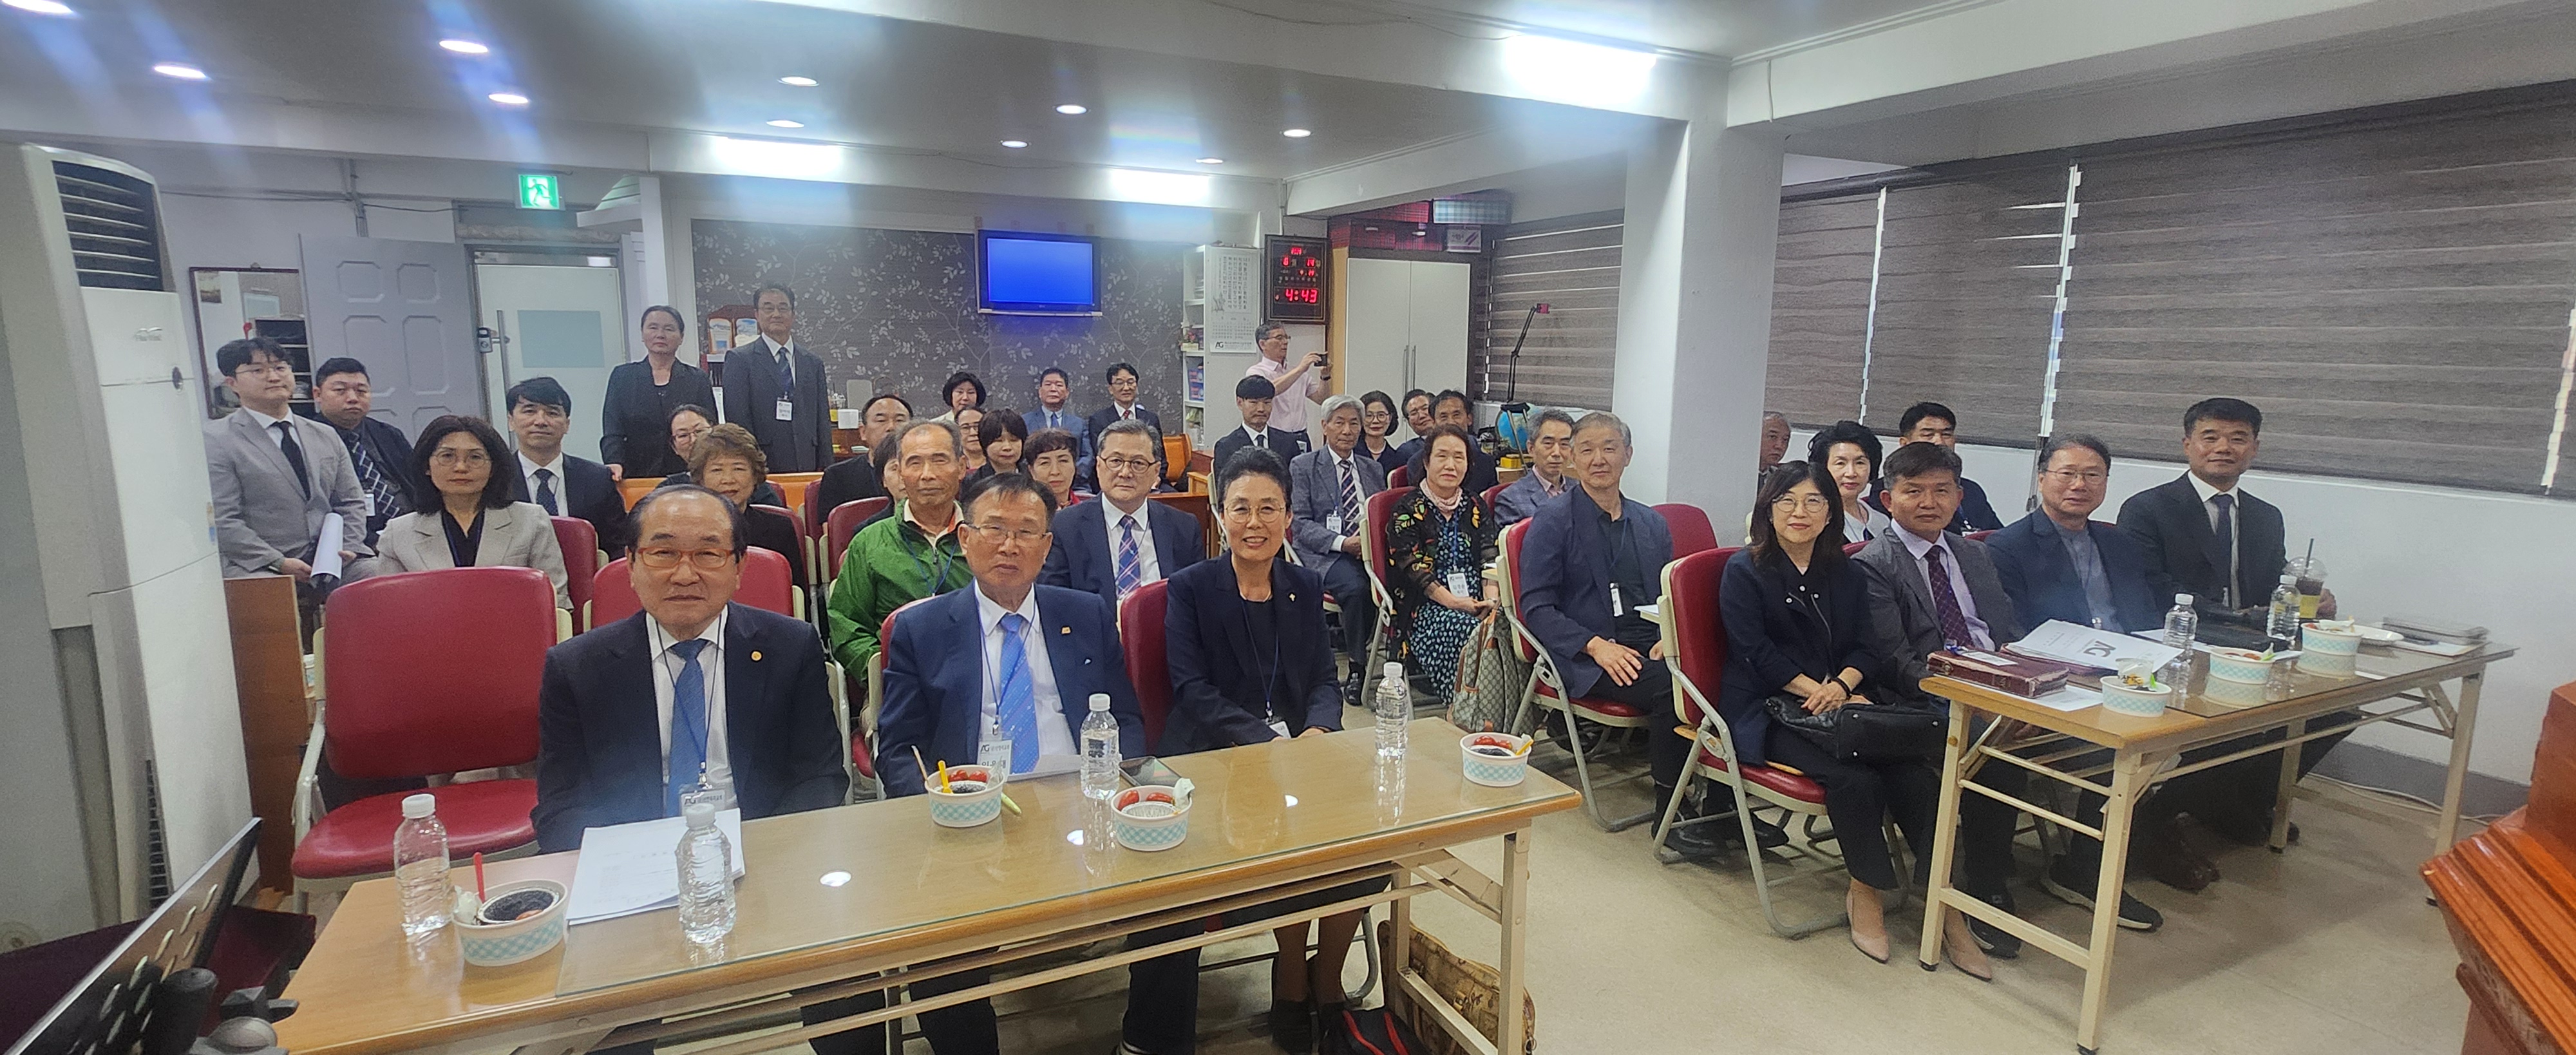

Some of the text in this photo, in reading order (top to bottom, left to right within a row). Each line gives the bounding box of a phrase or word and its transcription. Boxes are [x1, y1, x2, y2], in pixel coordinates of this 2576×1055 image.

[1285, 288, 1318, 303] 4:43
[2083, 640, 2117, 658] AG
[980, 744, 990, 753] AG
